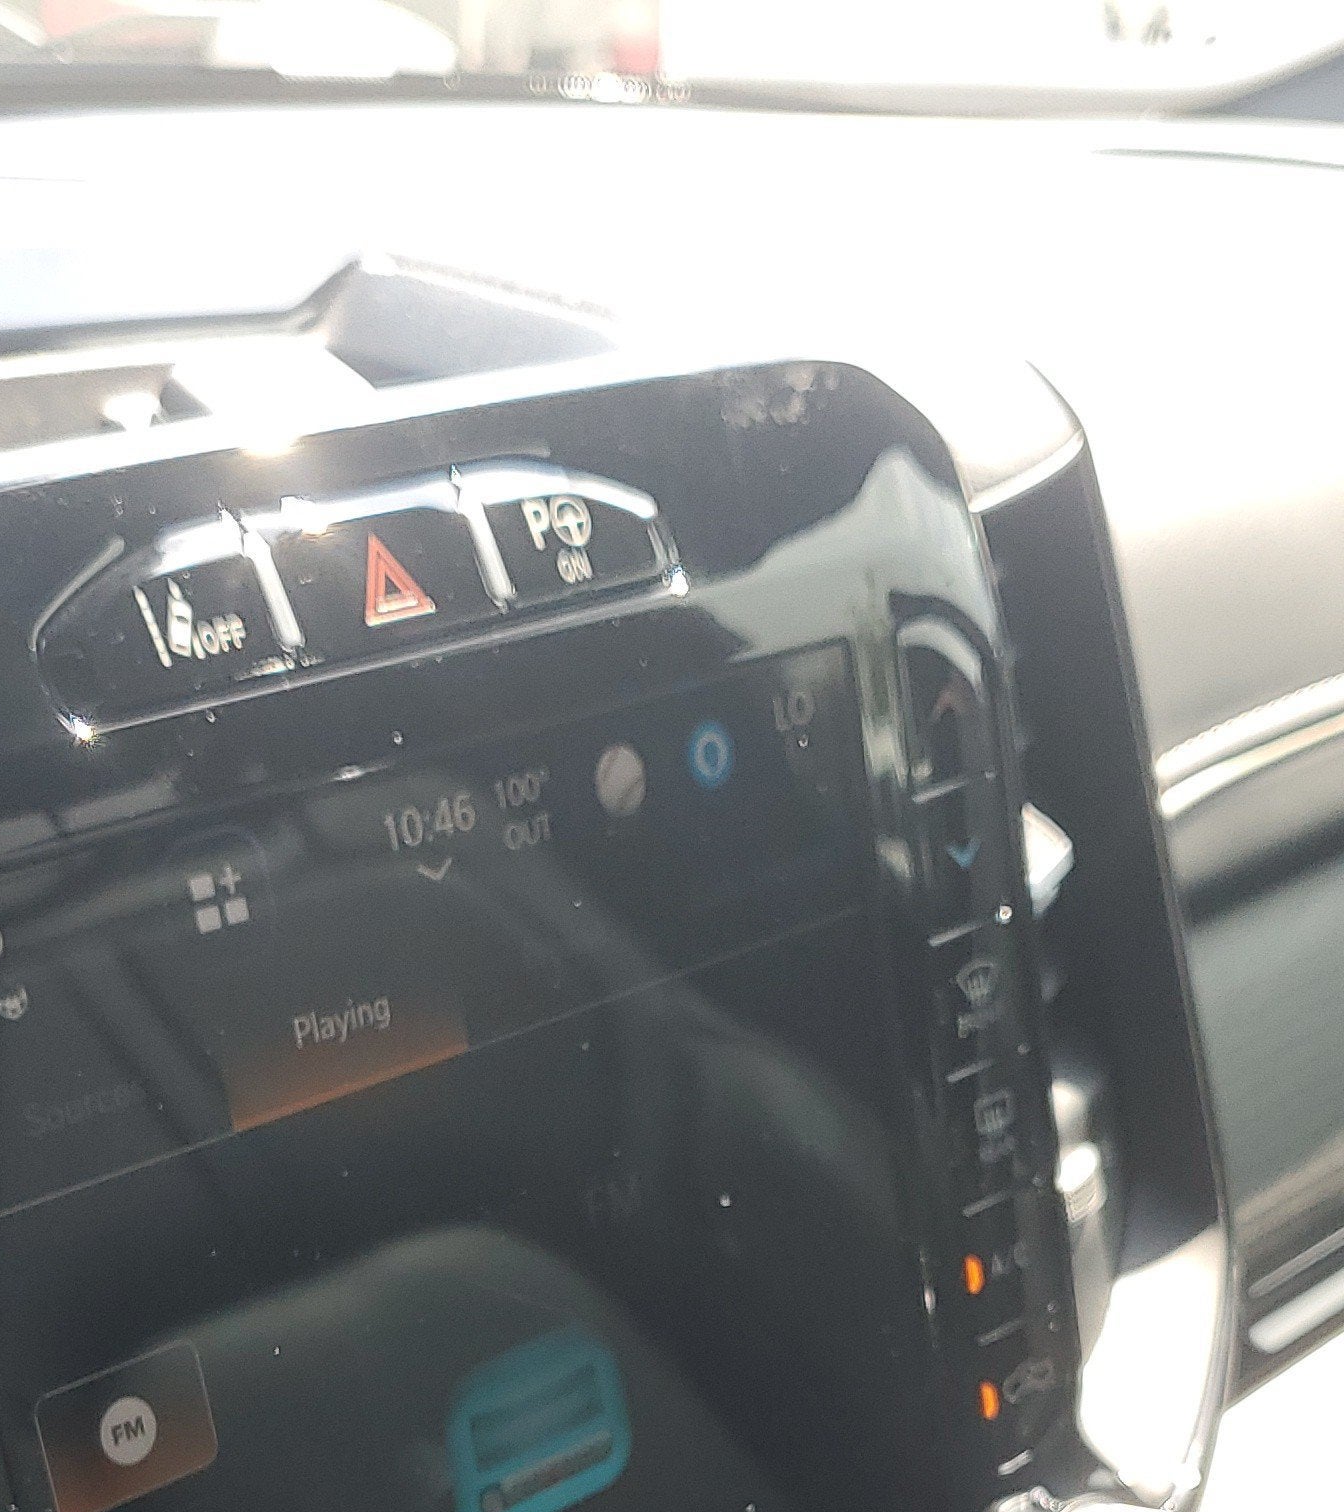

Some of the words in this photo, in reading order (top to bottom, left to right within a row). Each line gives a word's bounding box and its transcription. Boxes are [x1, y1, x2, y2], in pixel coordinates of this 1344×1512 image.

[557, 548, 593, 584] ON
[202, 612, 248, 657] OFF
[772, 688, 815, 732] LO
[383, 790, 477, 852] 10:46
[502, 811, 552, 851] OUT
[292, 995, 392, 1050] Playing
[109, 1415, 146, 1447] FM
